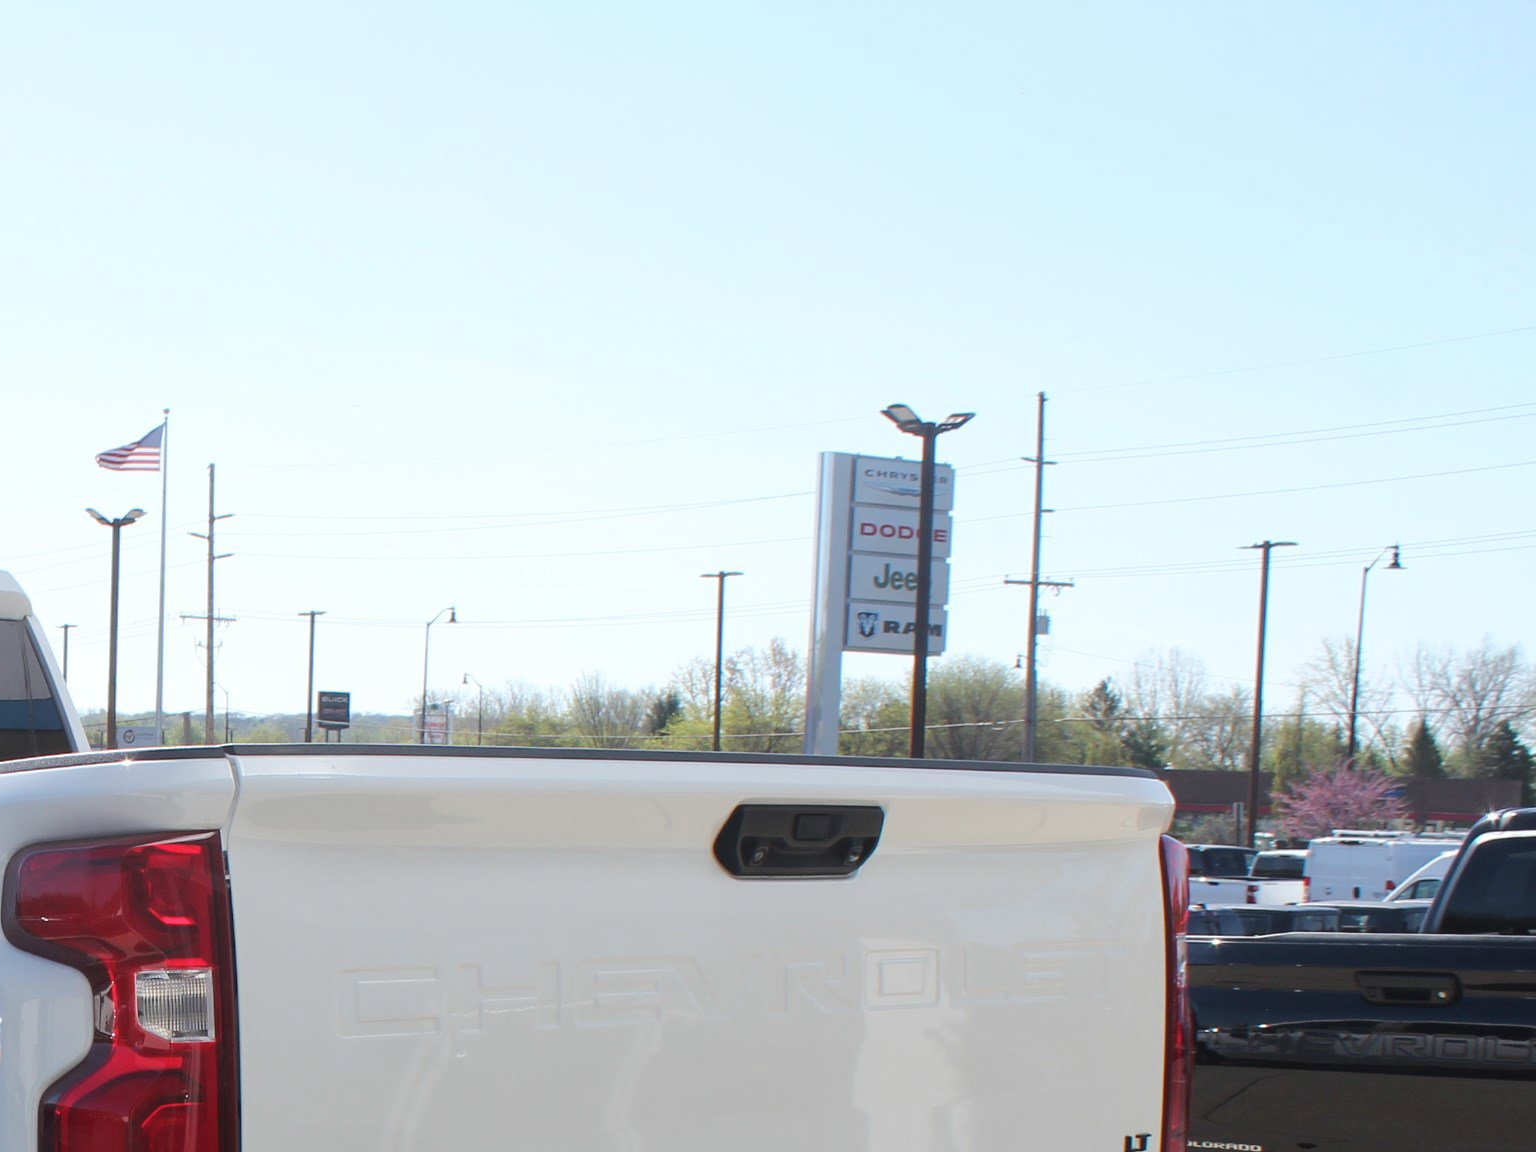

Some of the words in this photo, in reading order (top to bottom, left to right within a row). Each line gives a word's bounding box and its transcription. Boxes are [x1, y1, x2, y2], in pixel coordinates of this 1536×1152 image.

[865, 469, 948, 485] CHRYSR
[860, 522, 947, 543] DODE
[873, 563, 919, 592] Jee
[1123, 1133, 1152, 1152] LT
[1187, 1140, 1263, 1152] LORADO
